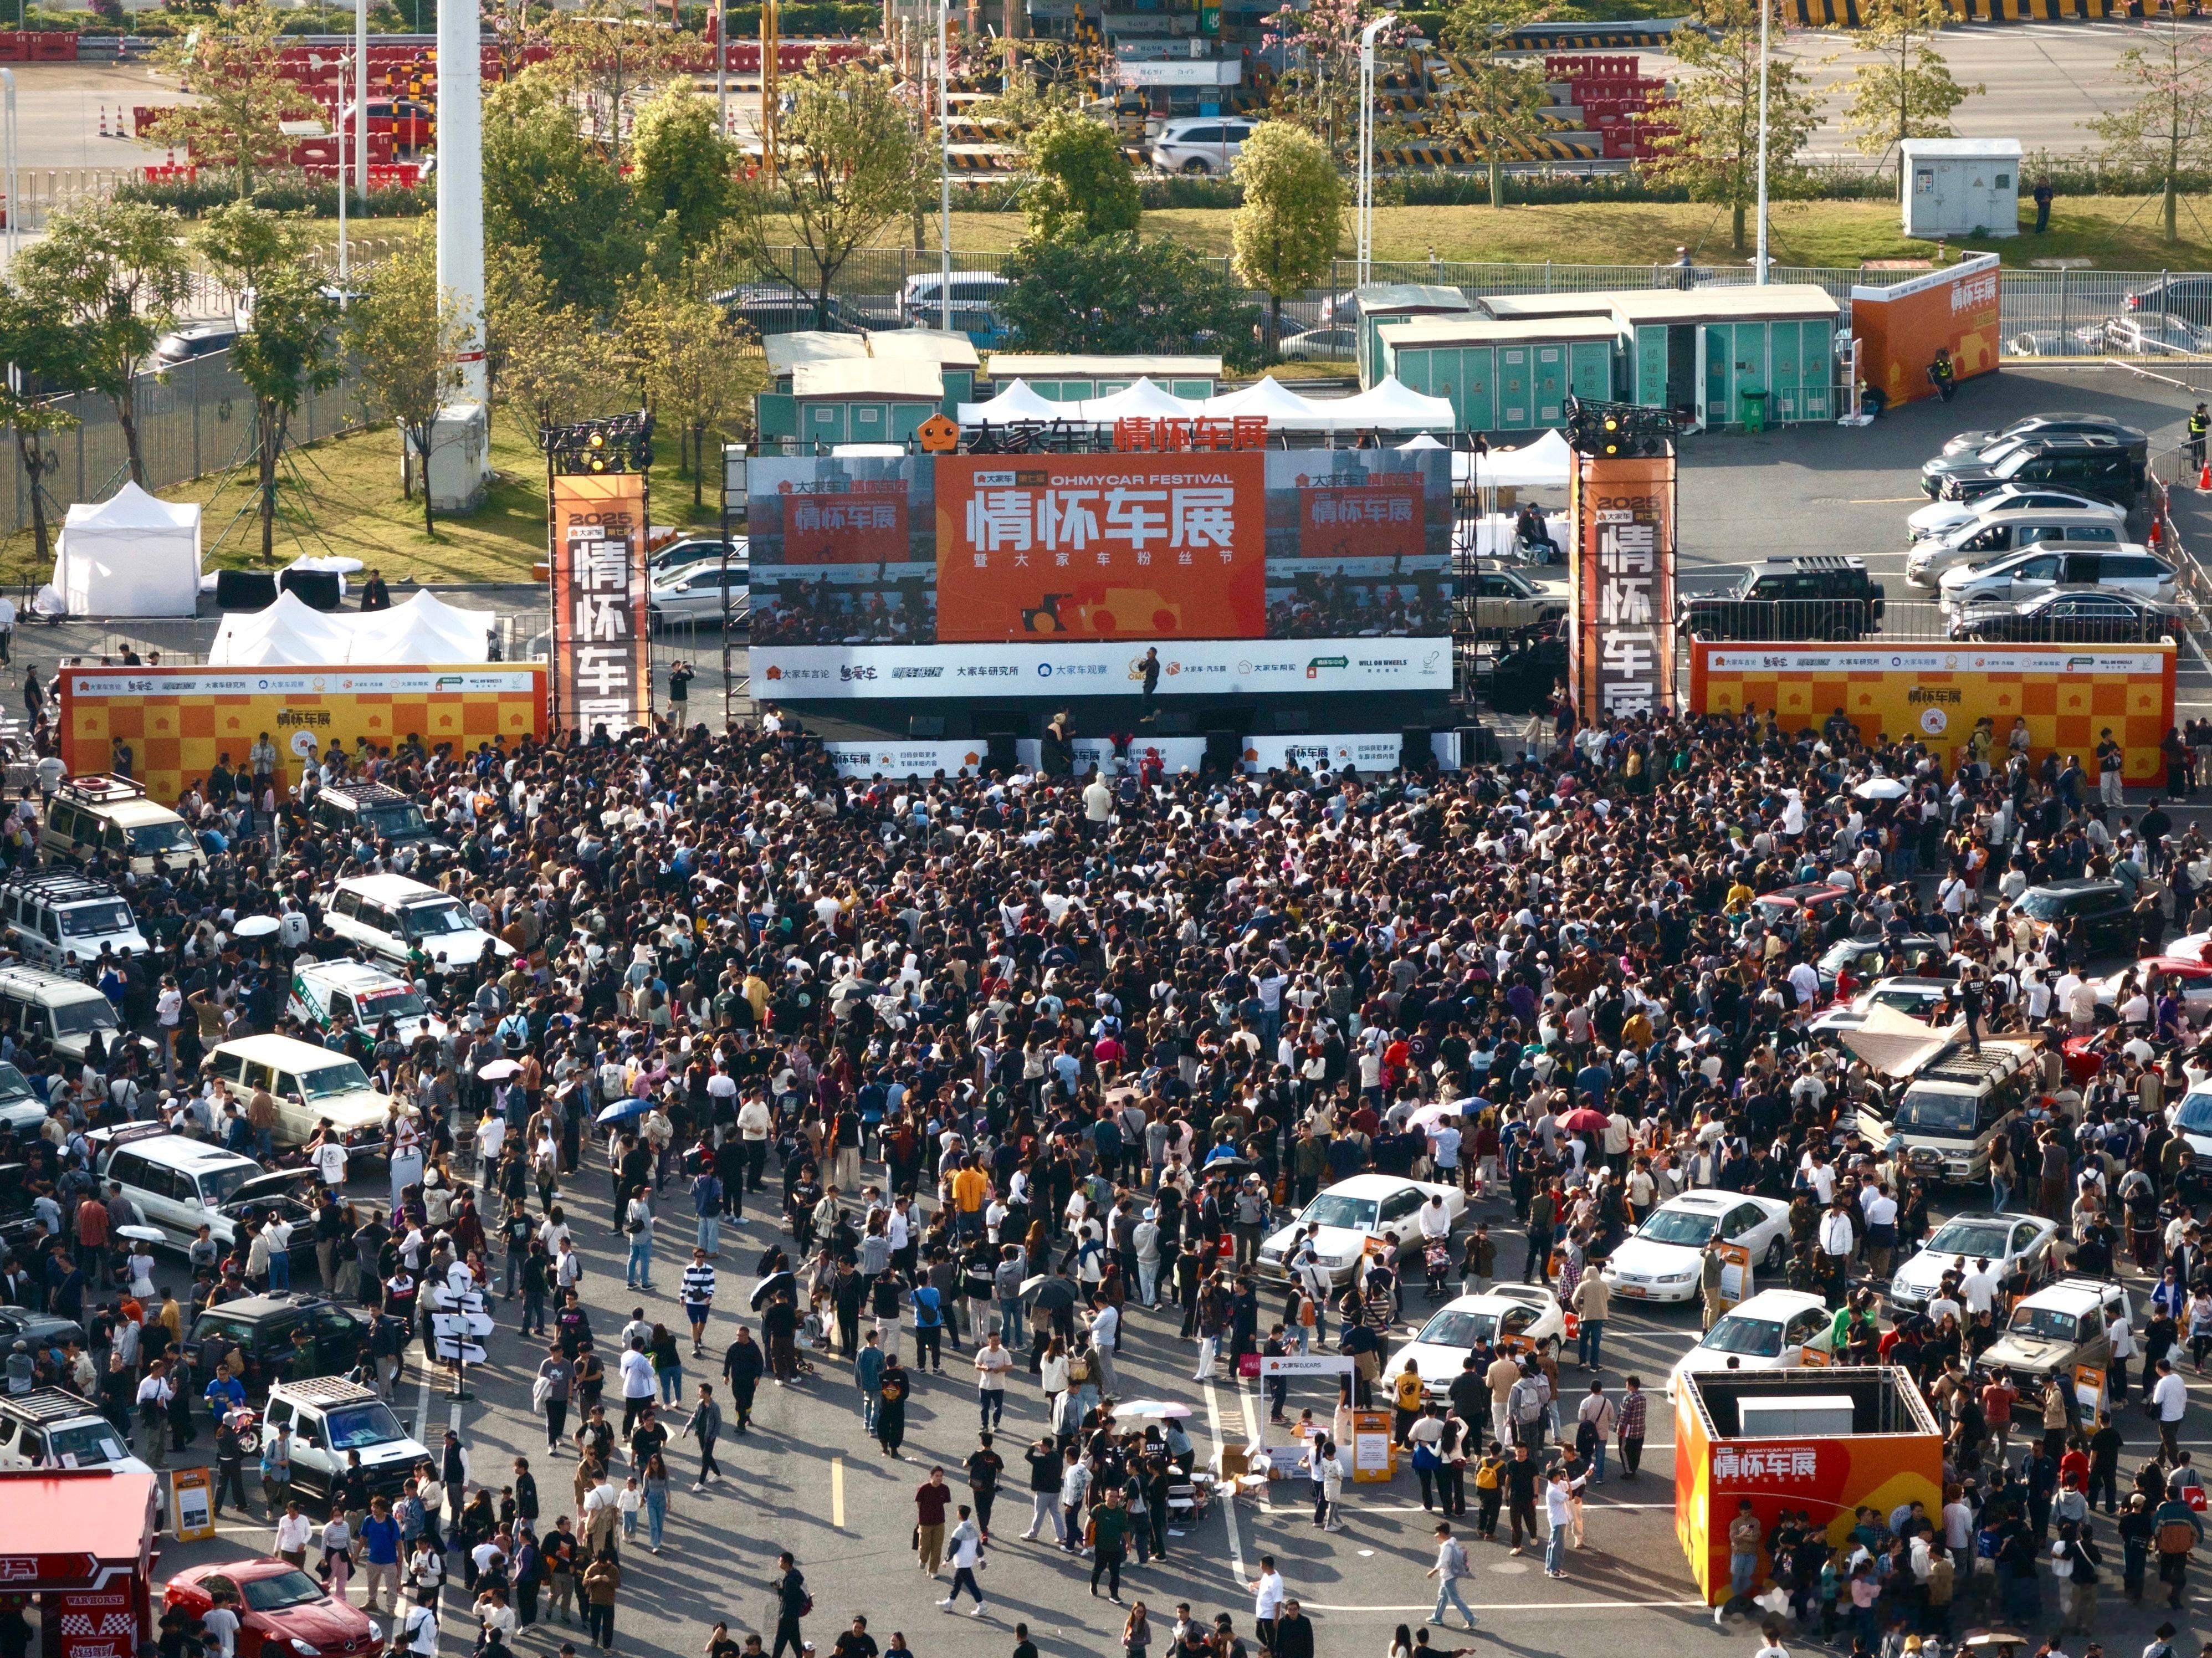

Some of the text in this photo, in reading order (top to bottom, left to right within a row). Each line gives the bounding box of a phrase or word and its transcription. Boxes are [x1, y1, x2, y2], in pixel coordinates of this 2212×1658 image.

[1951, 276, 1996, 311] 情怀车展
[966, 415, 1269, 453] 大家车 情怀车展
[1051, 474, 1233, 486] OHMYCAR FESTIVAL
[1597, 497, 1661, 509] 2025
[795, 506, 897, 529] 情怀车展
[1312, 499, 1412, 523] 情怀车展
[569, 512, 633, 525] 2025
[966, 488, 1234, 551] 情怀车展
[974, 551, 1233, 568] 暨大家车粉丝节
[1601, 524, 1653, 720] 情怀车展
[574, 541, 629, 745] 情怀车展
[782, 669, 830, 678] 大家车言论
[957, 666, 1019, 676] 大家车研究所
[1056, 664, 1107, 674] 大家车观察
[1908, 690, 1962, 703] 情怀车展
[277, 713, 330, 725] 情怀车展
[1285, 748, 1329, 758] 情怀车展
[293, 922, 299, 932] 5
[1713, 1452, 1816, 1478] 情怀车展
[66, 1595, 125, 1606] WAR HORSE
